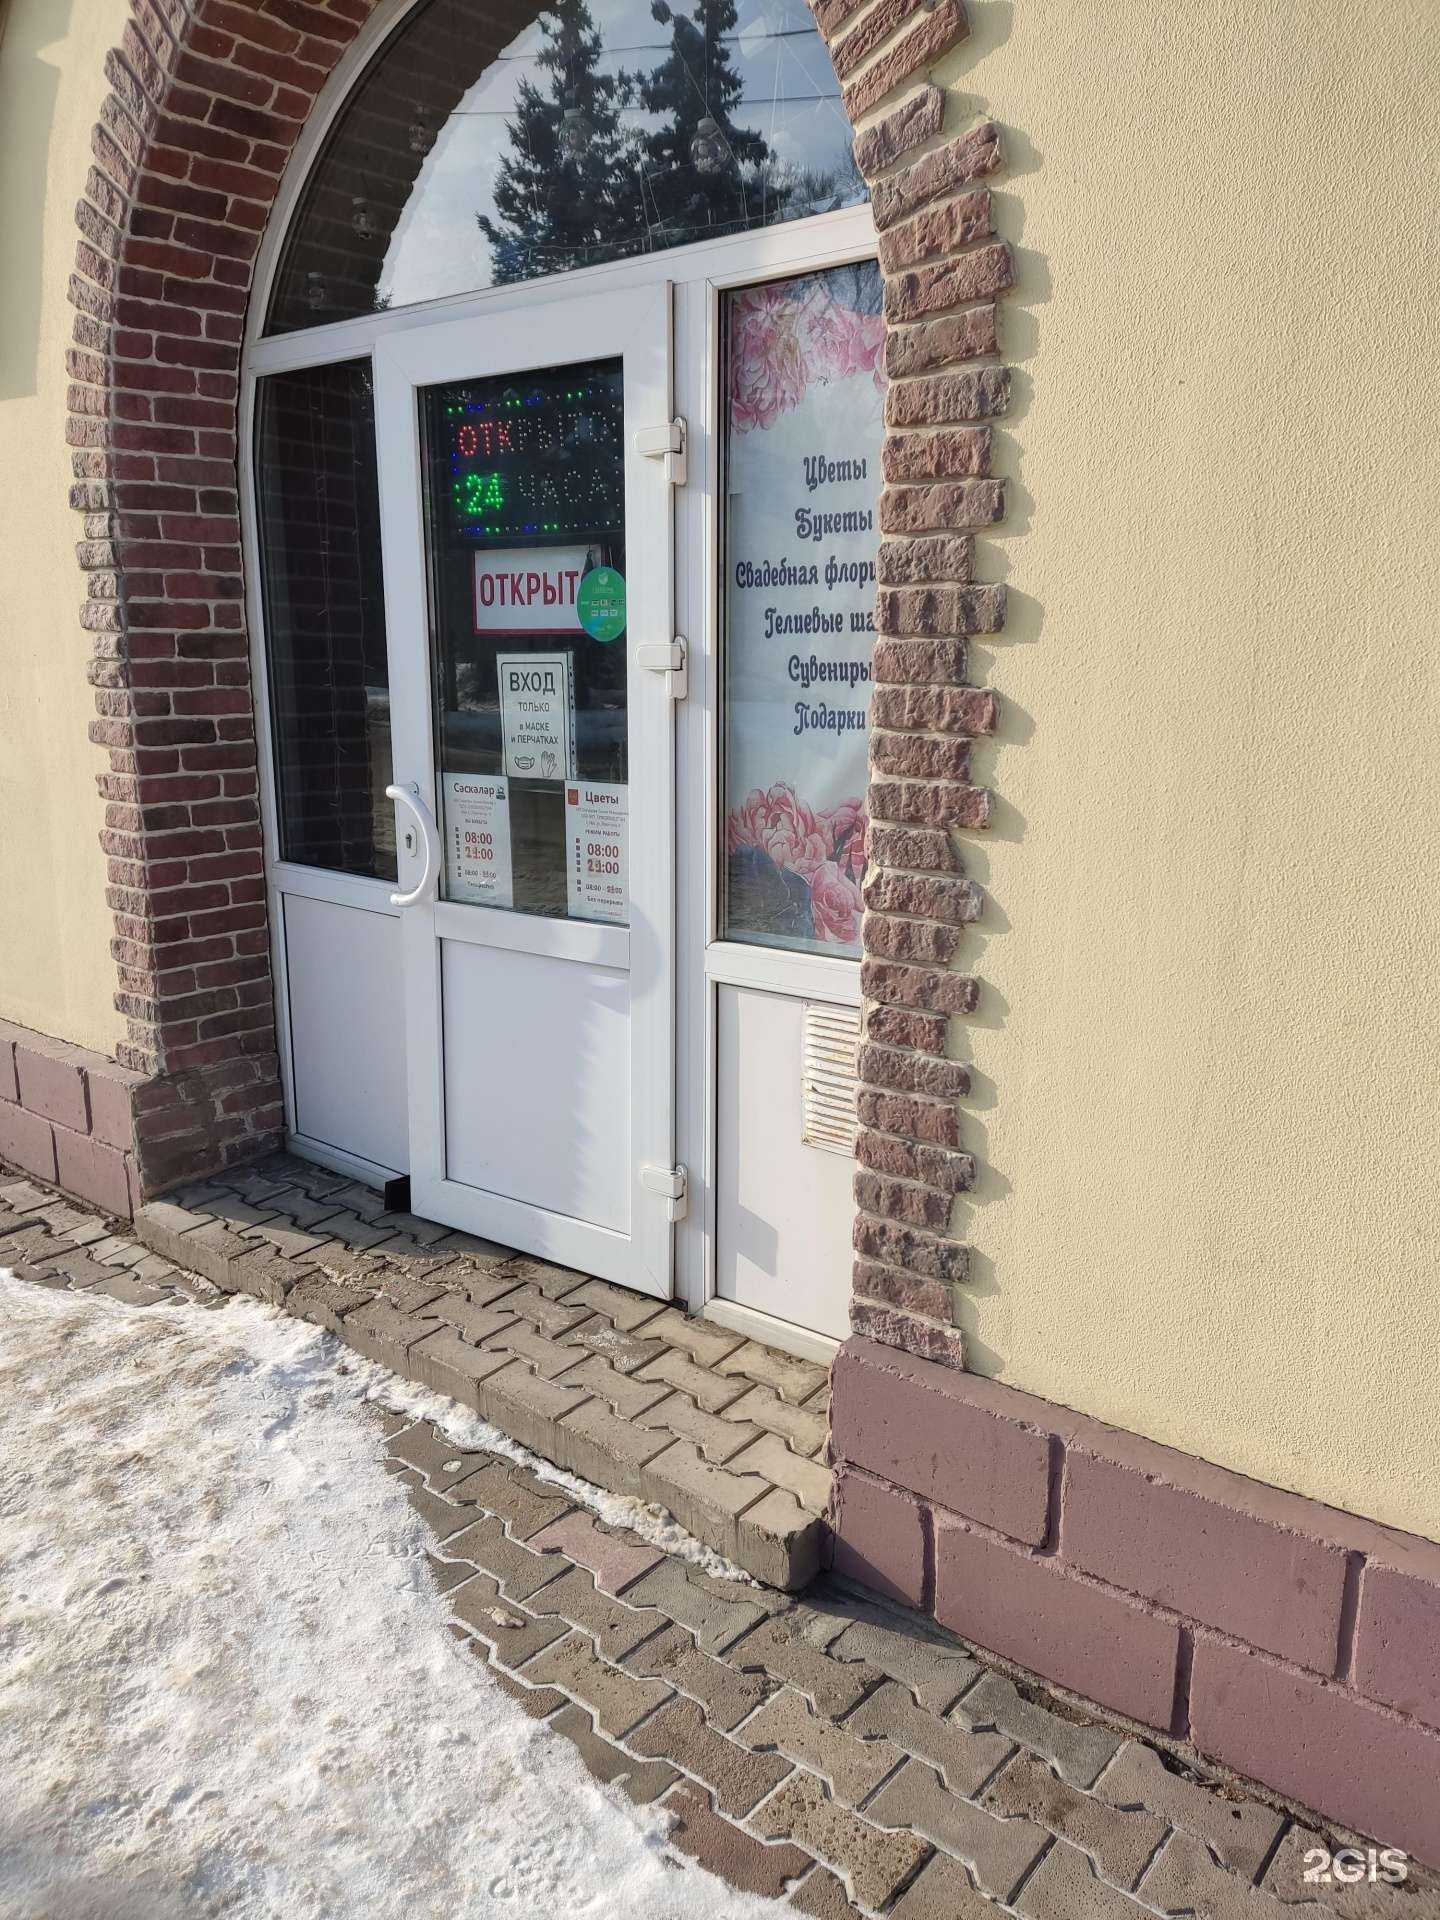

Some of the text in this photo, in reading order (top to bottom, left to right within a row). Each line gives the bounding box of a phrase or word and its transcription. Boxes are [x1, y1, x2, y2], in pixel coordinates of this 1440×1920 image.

[803, 455, 867, 492] Цветы
[465, 472, 504, 514] 24
[794, 507, 873, 542] Букеты
[479, 570, 579, 607] ОТКРЫТ
[735, 557, 819, 589] Свадебная
[764, 606, 843, 639] Гелиевые
[509, 671, 556, 696] ВХОД
[788, 654, 872, 688] Сувениры
[518, 701, 550, 713] ТОЛЬКО
[793, 702, 866, 736] Подарки
[517, 734, 559, 745] ПЕРЧАТКАХ
[525, 721, 550, 732] МАСКЕ
[585, 791, 619, 805] Цветы
[464, 831, 493, 845] 08:00
[587, 843, 619, 858] 08:00
